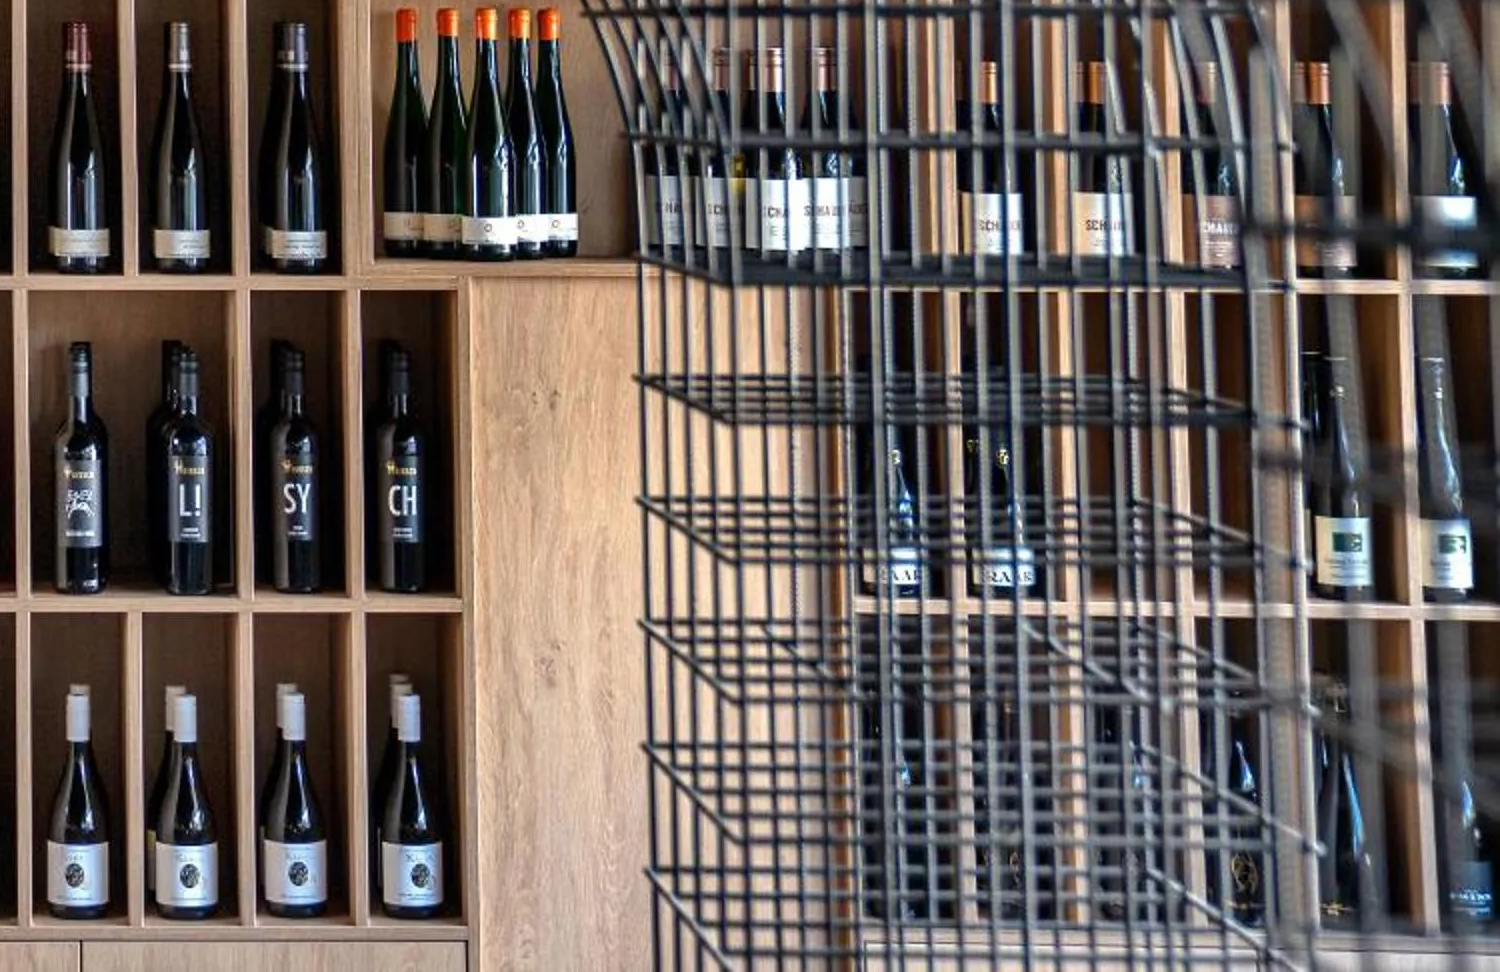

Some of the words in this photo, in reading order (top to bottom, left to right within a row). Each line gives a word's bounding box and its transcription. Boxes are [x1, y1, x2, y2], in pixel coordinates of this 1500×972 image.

[179, 483, 201, 517] L!
[283, 483, 311, 515] SY
[387, 484, 418, 517] CH
